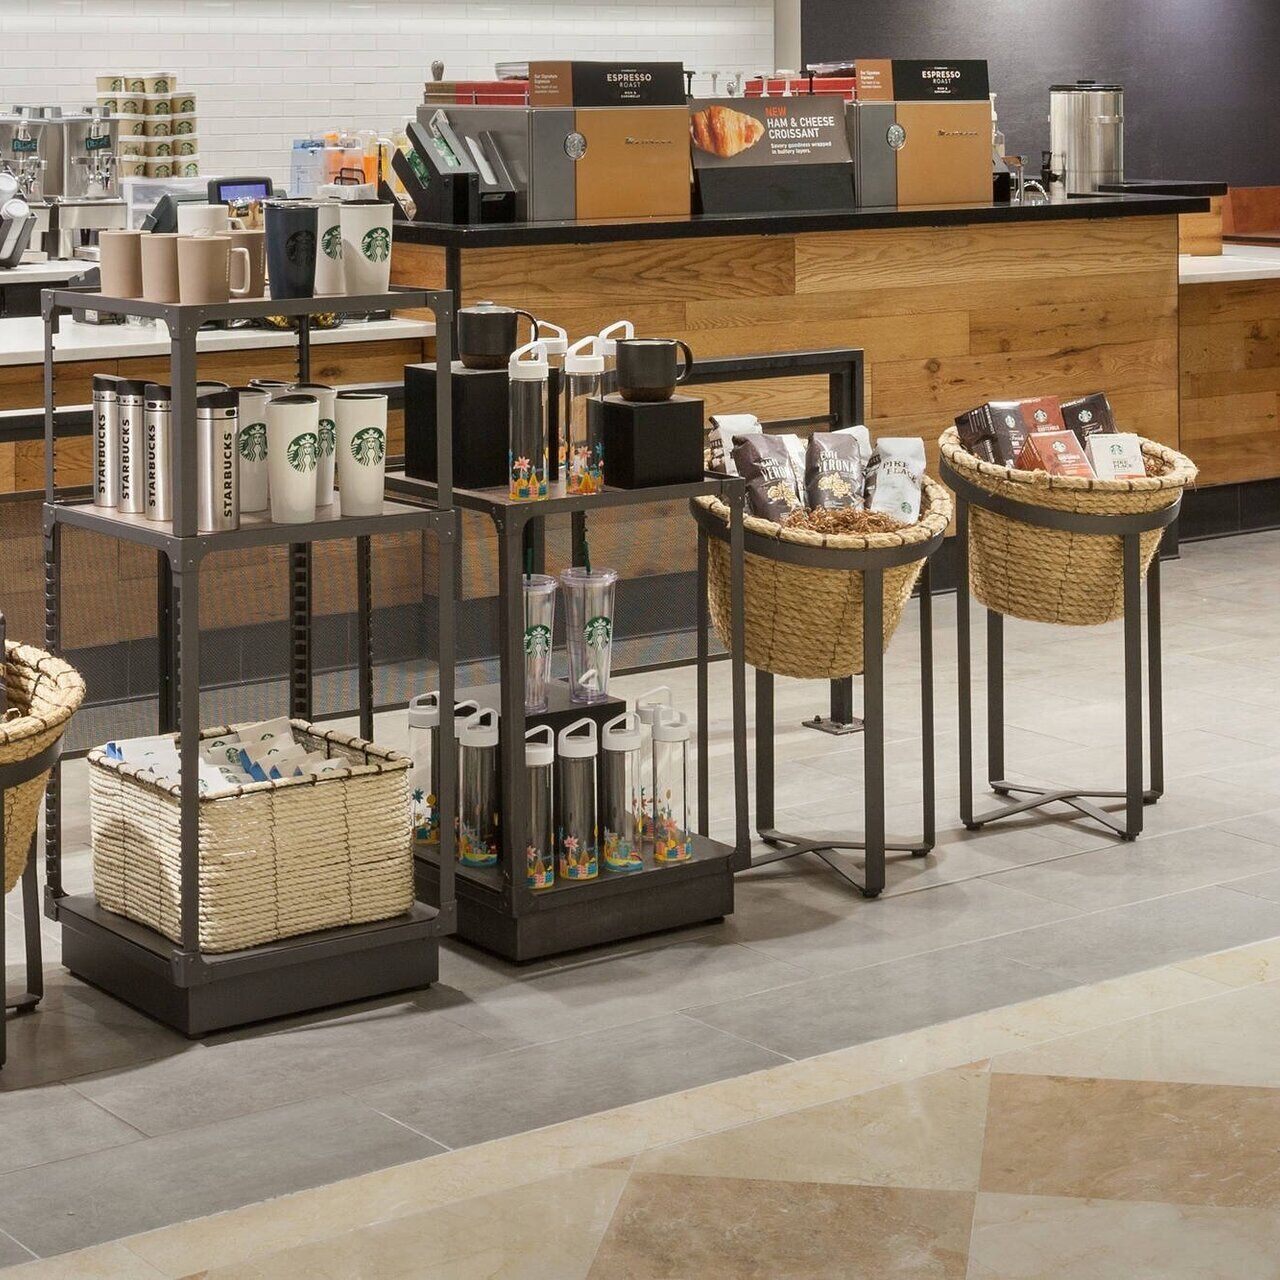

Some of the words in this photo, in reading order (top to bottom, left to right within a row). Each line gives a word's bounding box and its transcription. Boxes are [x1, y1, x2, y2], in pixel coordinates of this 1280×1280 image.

[607, 74, 652, 82] ESPRESSO
[765, 107, 786, 117] NEW
[767, 118, 788, 128] HAM
[791, 118, 797, 127] &
[800, 116, 835, 127] CHEESE
[769, 128, 819, 139] CROISSANT
[97, 413, 106, 495] STARBUCKS
[122, 418, 130, 500] STARBUCKS
[148, 424, 156, 507] STARBUCKS
[224, 432, 233, 518] STARBUCKS
